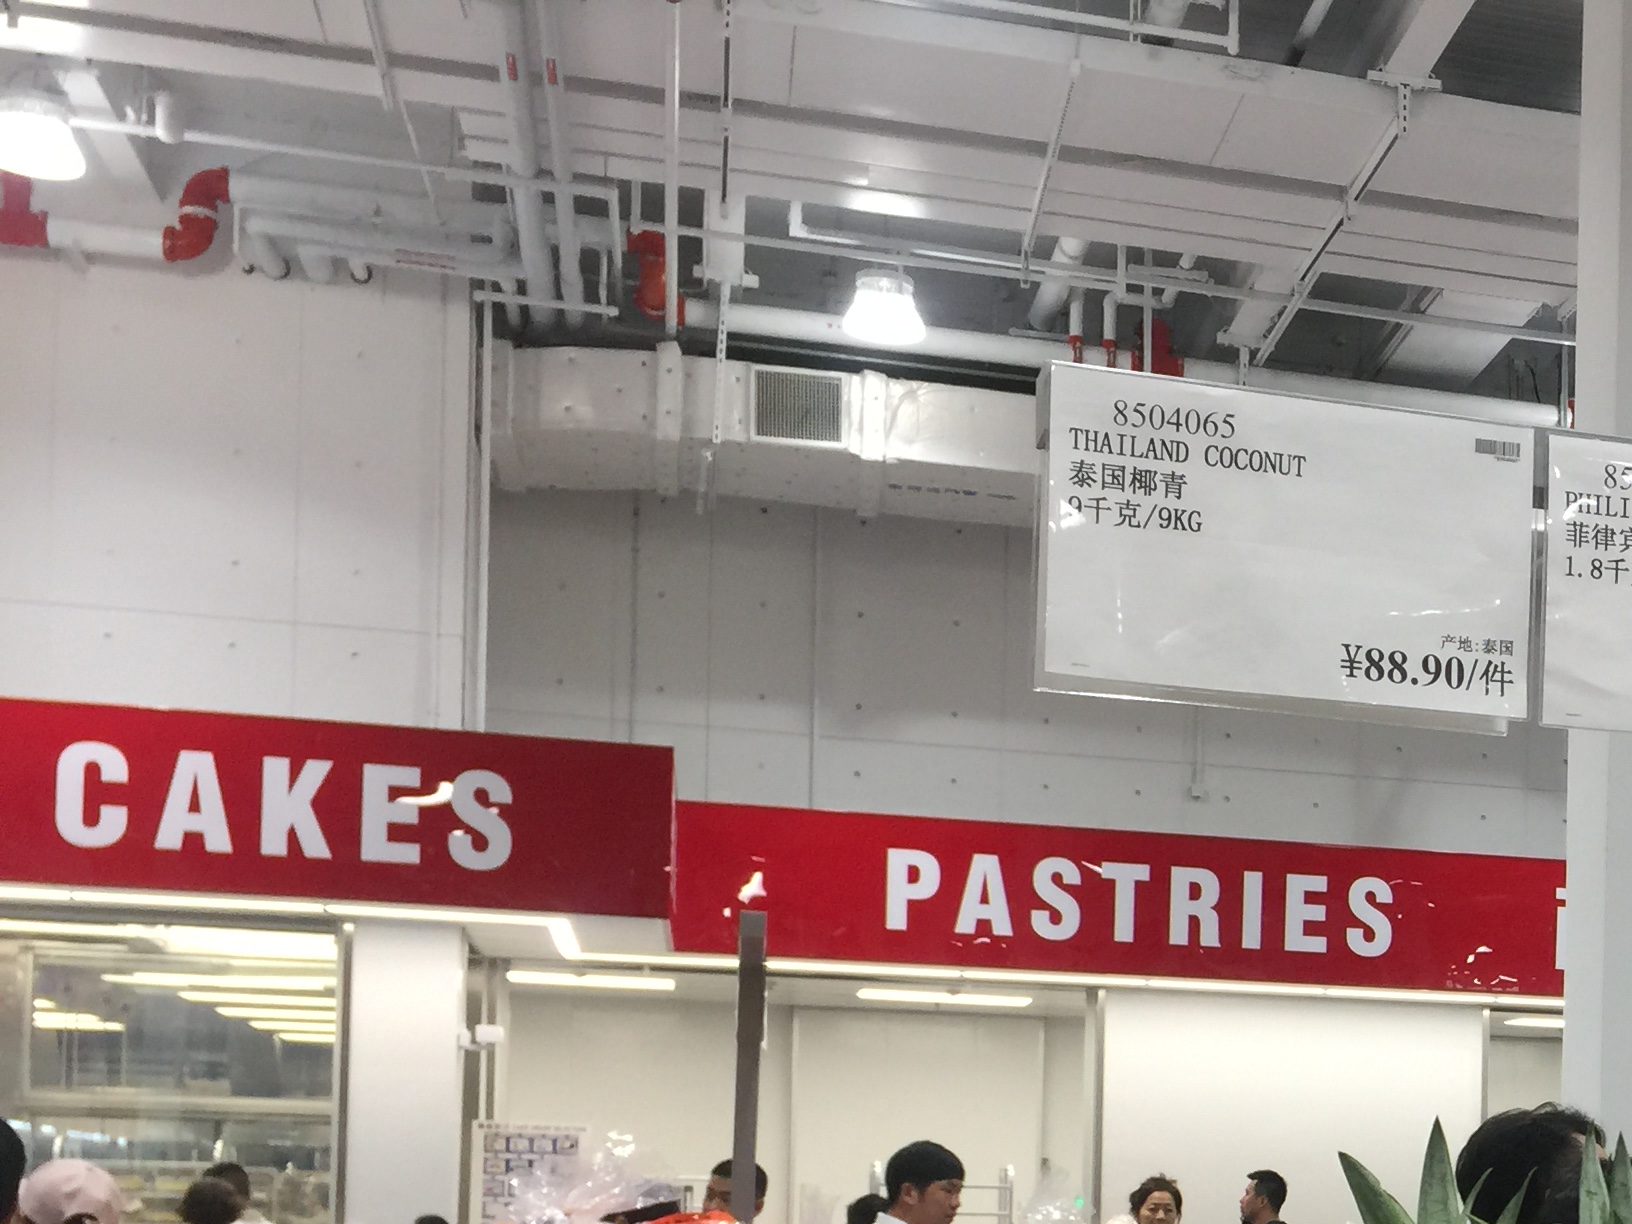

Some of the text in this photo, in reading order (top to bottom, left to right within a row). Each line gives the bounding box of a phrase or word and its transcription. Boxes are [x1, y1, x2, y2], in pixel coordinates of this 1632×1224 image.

[1113, 399, 1236, 439] 8504065
[1069, 426, 1307, 478] THAILAND COCONUT
[1068, 460, 1188, 500] 泰国椰青
[55, 740, 513, 872] CAKES
[885, 846, 1396, 958] PASTRIES
